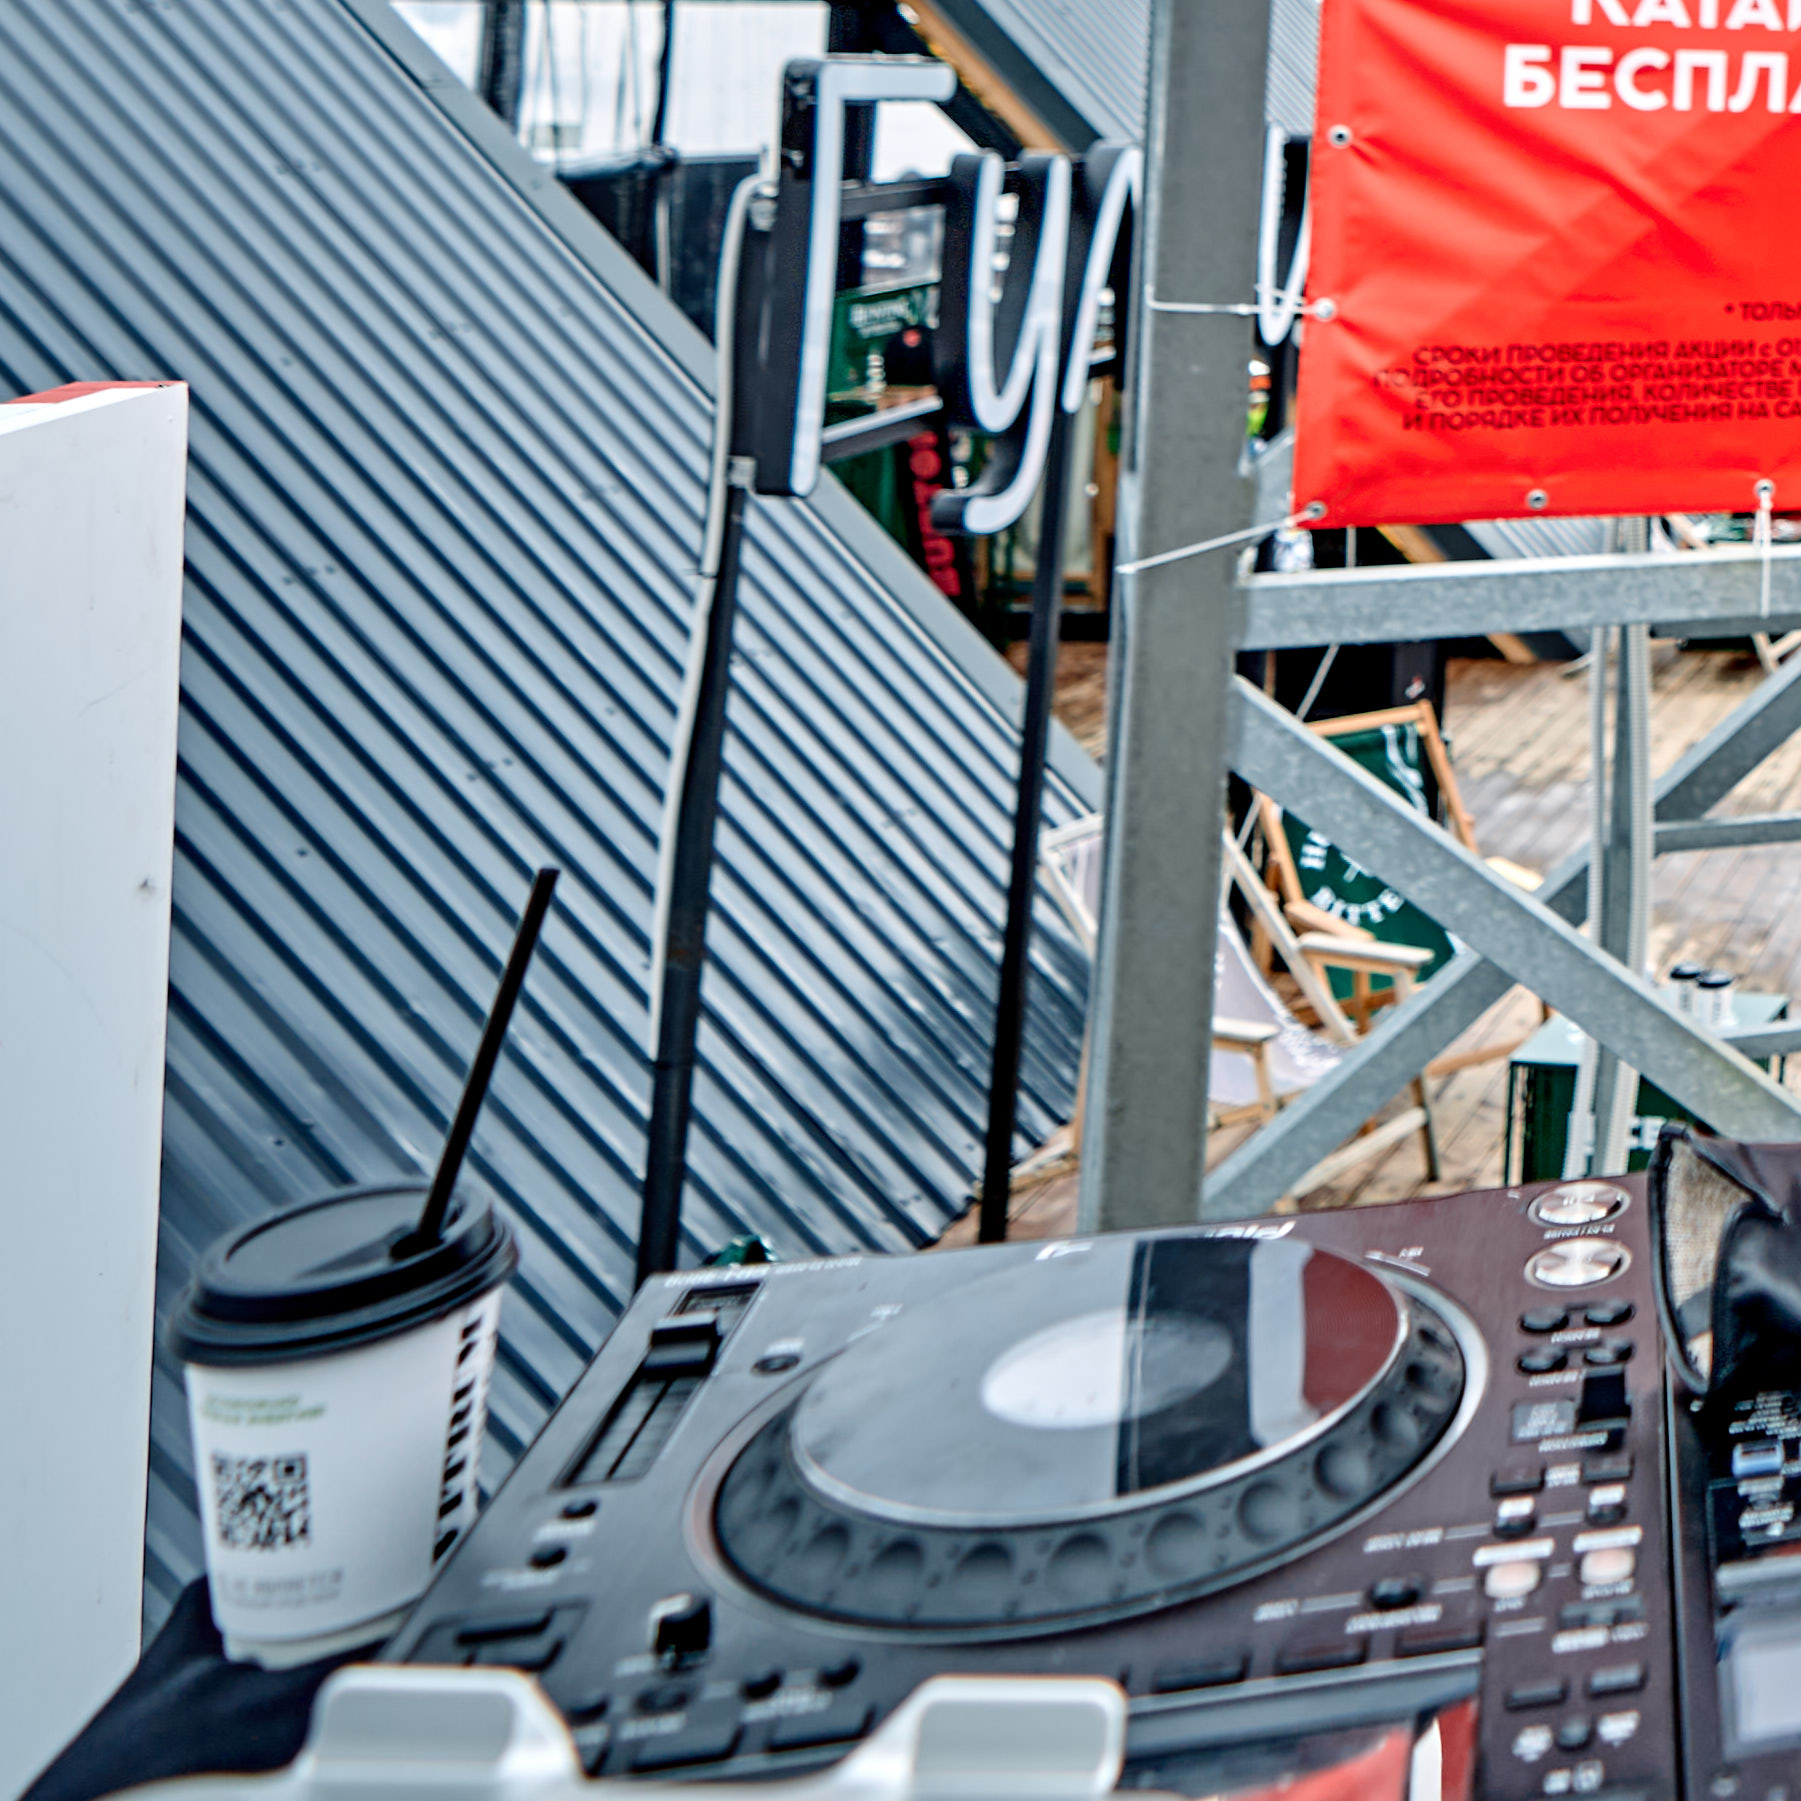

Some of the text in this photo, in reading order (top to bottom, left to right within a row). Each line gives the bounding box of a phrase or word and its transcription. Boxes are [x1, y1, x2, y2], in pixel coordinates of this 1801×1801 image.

[1413, 345, 1500, 366] СРОКИ
[1506, 341, 1669, 363] ПРОВЕДЕНИЯ
[1674, 339, 1754, 360] АКЦИИ
[1374, 364, 1564, 388] ПОДРОБНОСТИ
[1571, 365, 1603, 384] ОБ
[1609, 359, 1786, 383] ОРГАНИЗАТОРЕ
[1643, 378, 1796, 402] КОЛИЧЕСТВЕ
[1428, 408, 1546, 431] ПОРЯДКЕ
[1552, 407, 1583, 427] ИХ
[1589, 402, 1731, 426] ПОЛУЧЕНИЯ
[1736, 402, 1771, 421] НА
